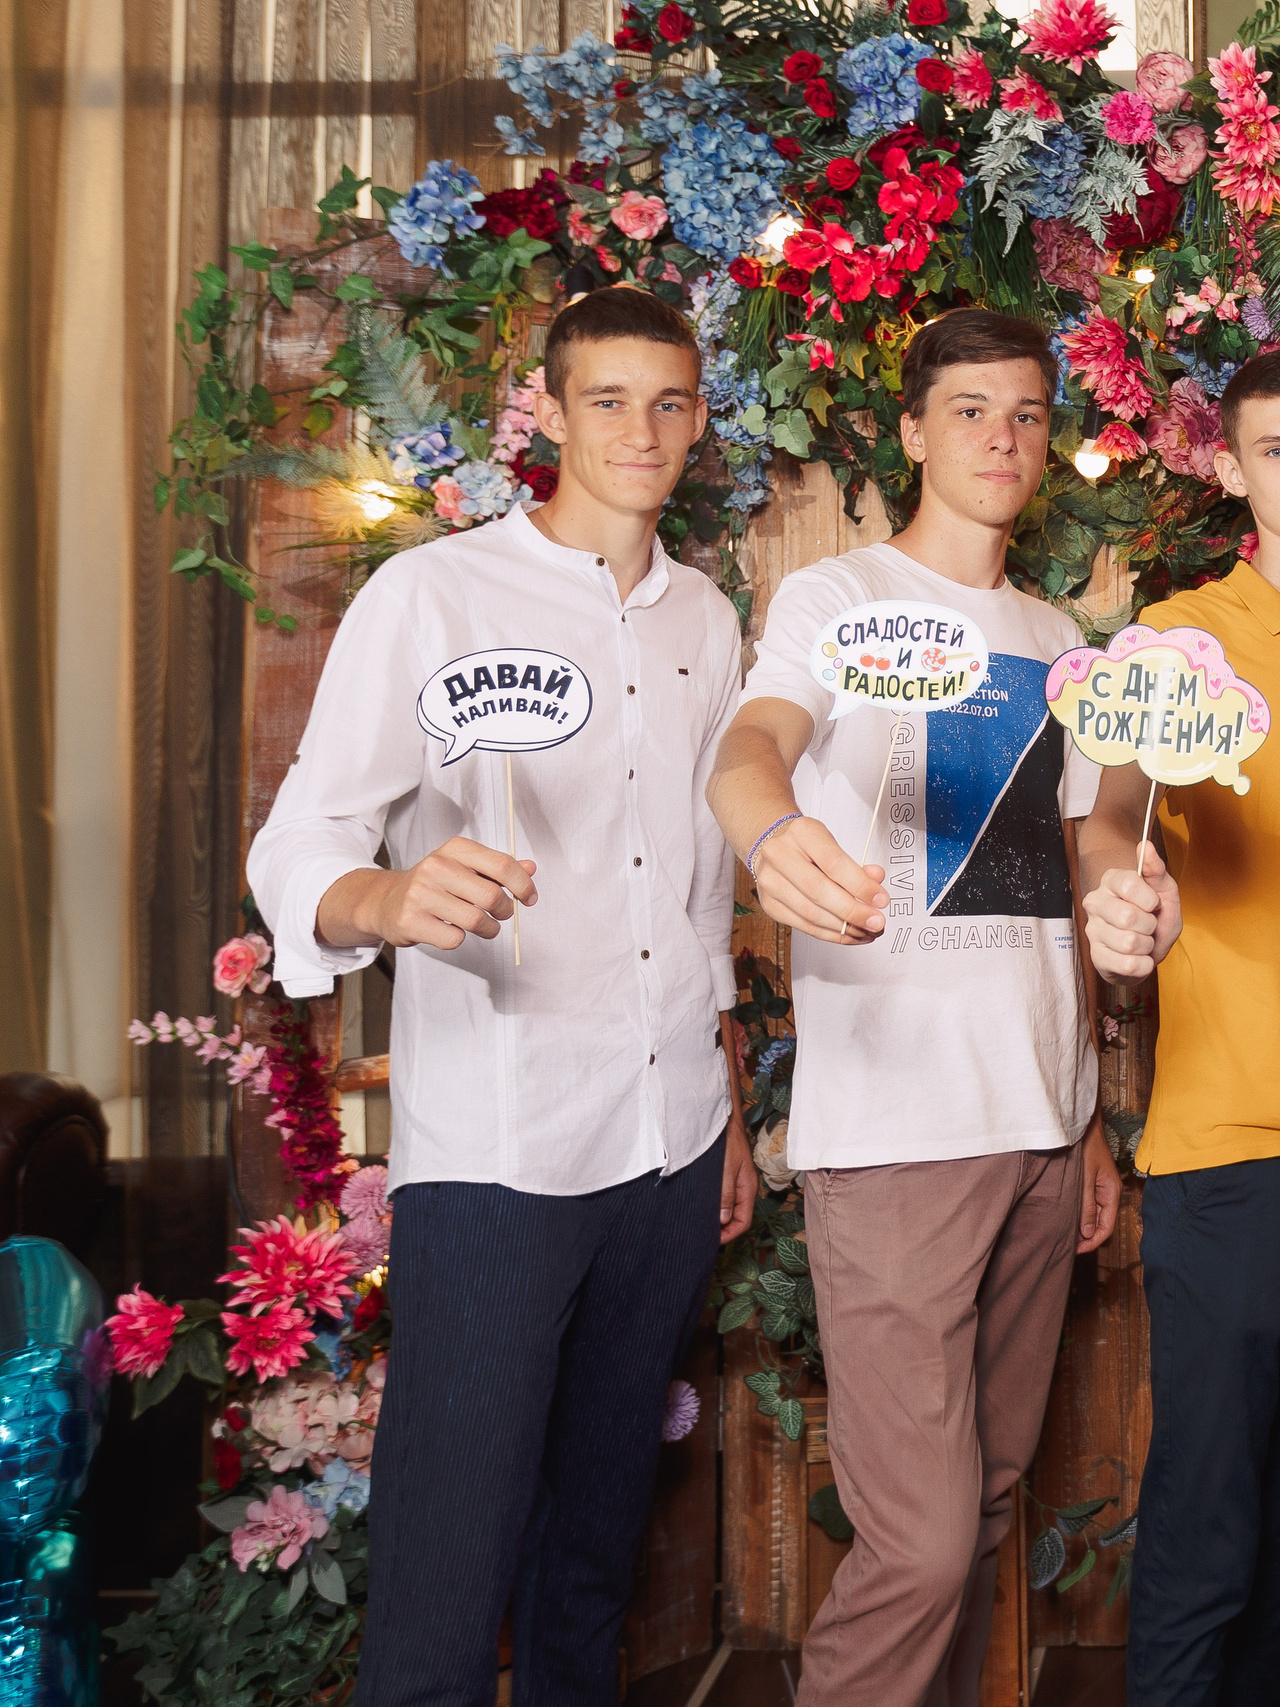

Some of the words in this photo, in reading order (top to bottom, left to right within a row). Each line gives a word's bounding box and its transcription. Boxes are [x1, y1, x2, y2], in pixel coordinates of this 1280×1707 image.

[837, 615, 964, 648] СЛАДОСТЕЙ
[897, 647, 912, 669] И
[443, 664, 573, 707] ДАВАЙ
[843, 665, 965, 701] РАДОСТЕЙ!
[1092, 672, 1112, 698] С
[452, 698, 569, 729] НАЛИВАЙ!
[889, 709, 916, 917] GRESSIVE
[918, 924, 1033, 951] CHANGE
